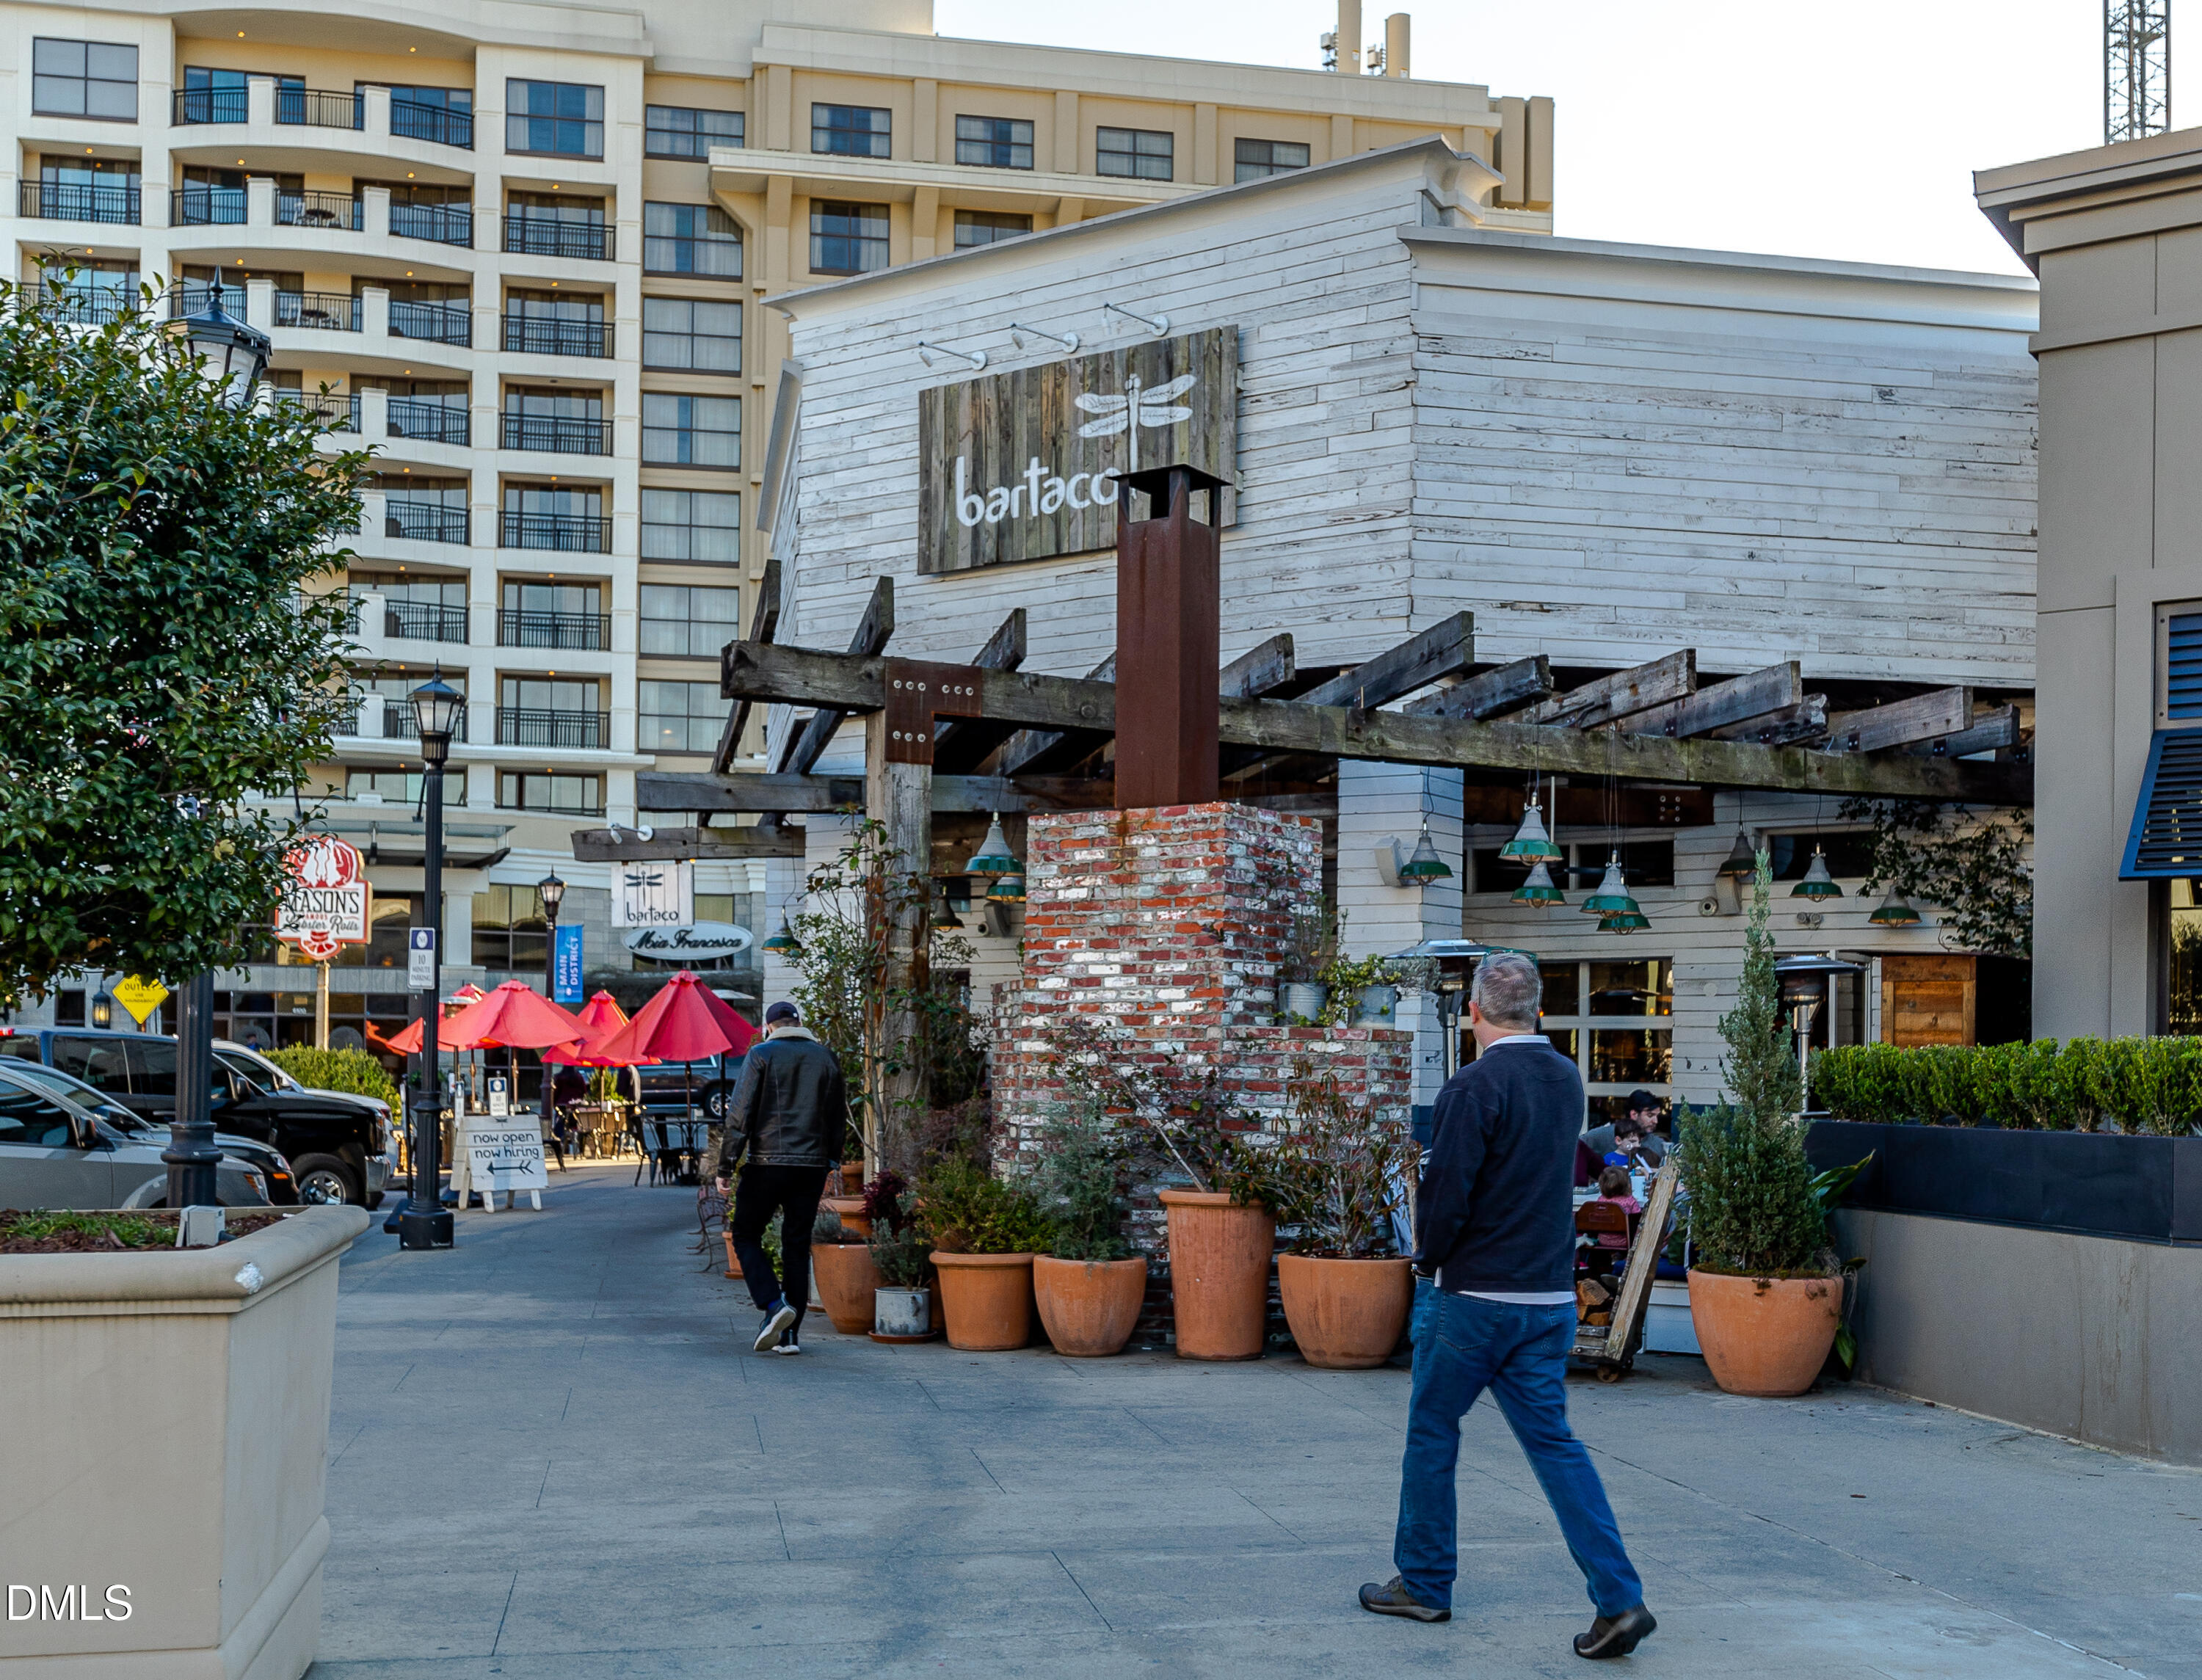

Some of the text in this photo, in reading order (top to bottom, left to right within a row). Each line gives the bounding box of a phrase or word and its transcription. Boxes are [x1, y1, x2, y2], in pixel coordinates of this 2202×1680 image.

[955, 456, 1122, 528] bartaco
[626, 901, 680, 922] bartaco
[629, 928, 743, 950] Mia Francesca
[418, 954, 426, 965] 10
[559, 954, 568, 986] MAIN
[570, 936, 579, 986] DISTRICT
[473, 1132, 534, 1145] now open
[475, 1146, 539, 1160] now hiring
